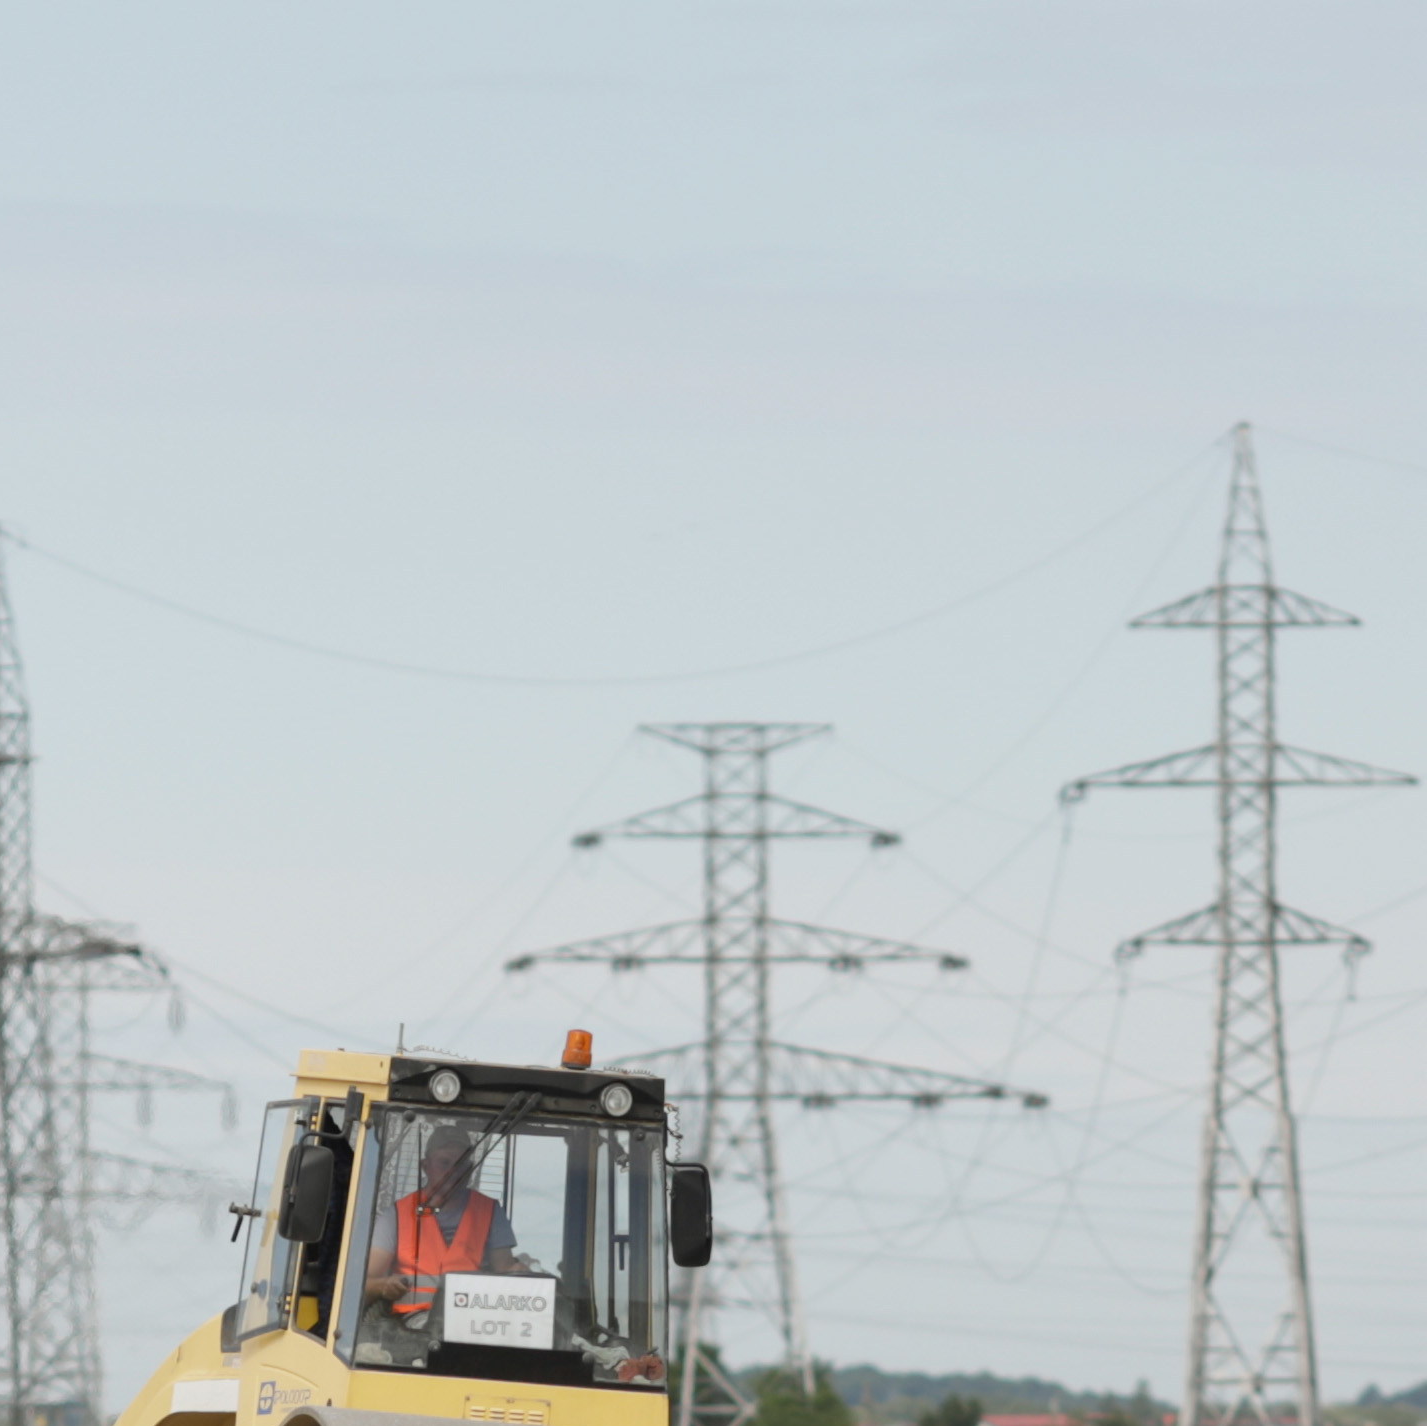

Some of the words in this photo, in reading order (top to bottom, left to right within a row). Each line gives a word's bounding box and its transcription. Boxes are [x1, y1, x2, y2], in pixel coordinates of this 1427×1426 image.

[470, 1294, 547, 1312] ALARKO
[470, 1320, 510, 1336] LOT
[520, 1322, 533, 1337] 2
